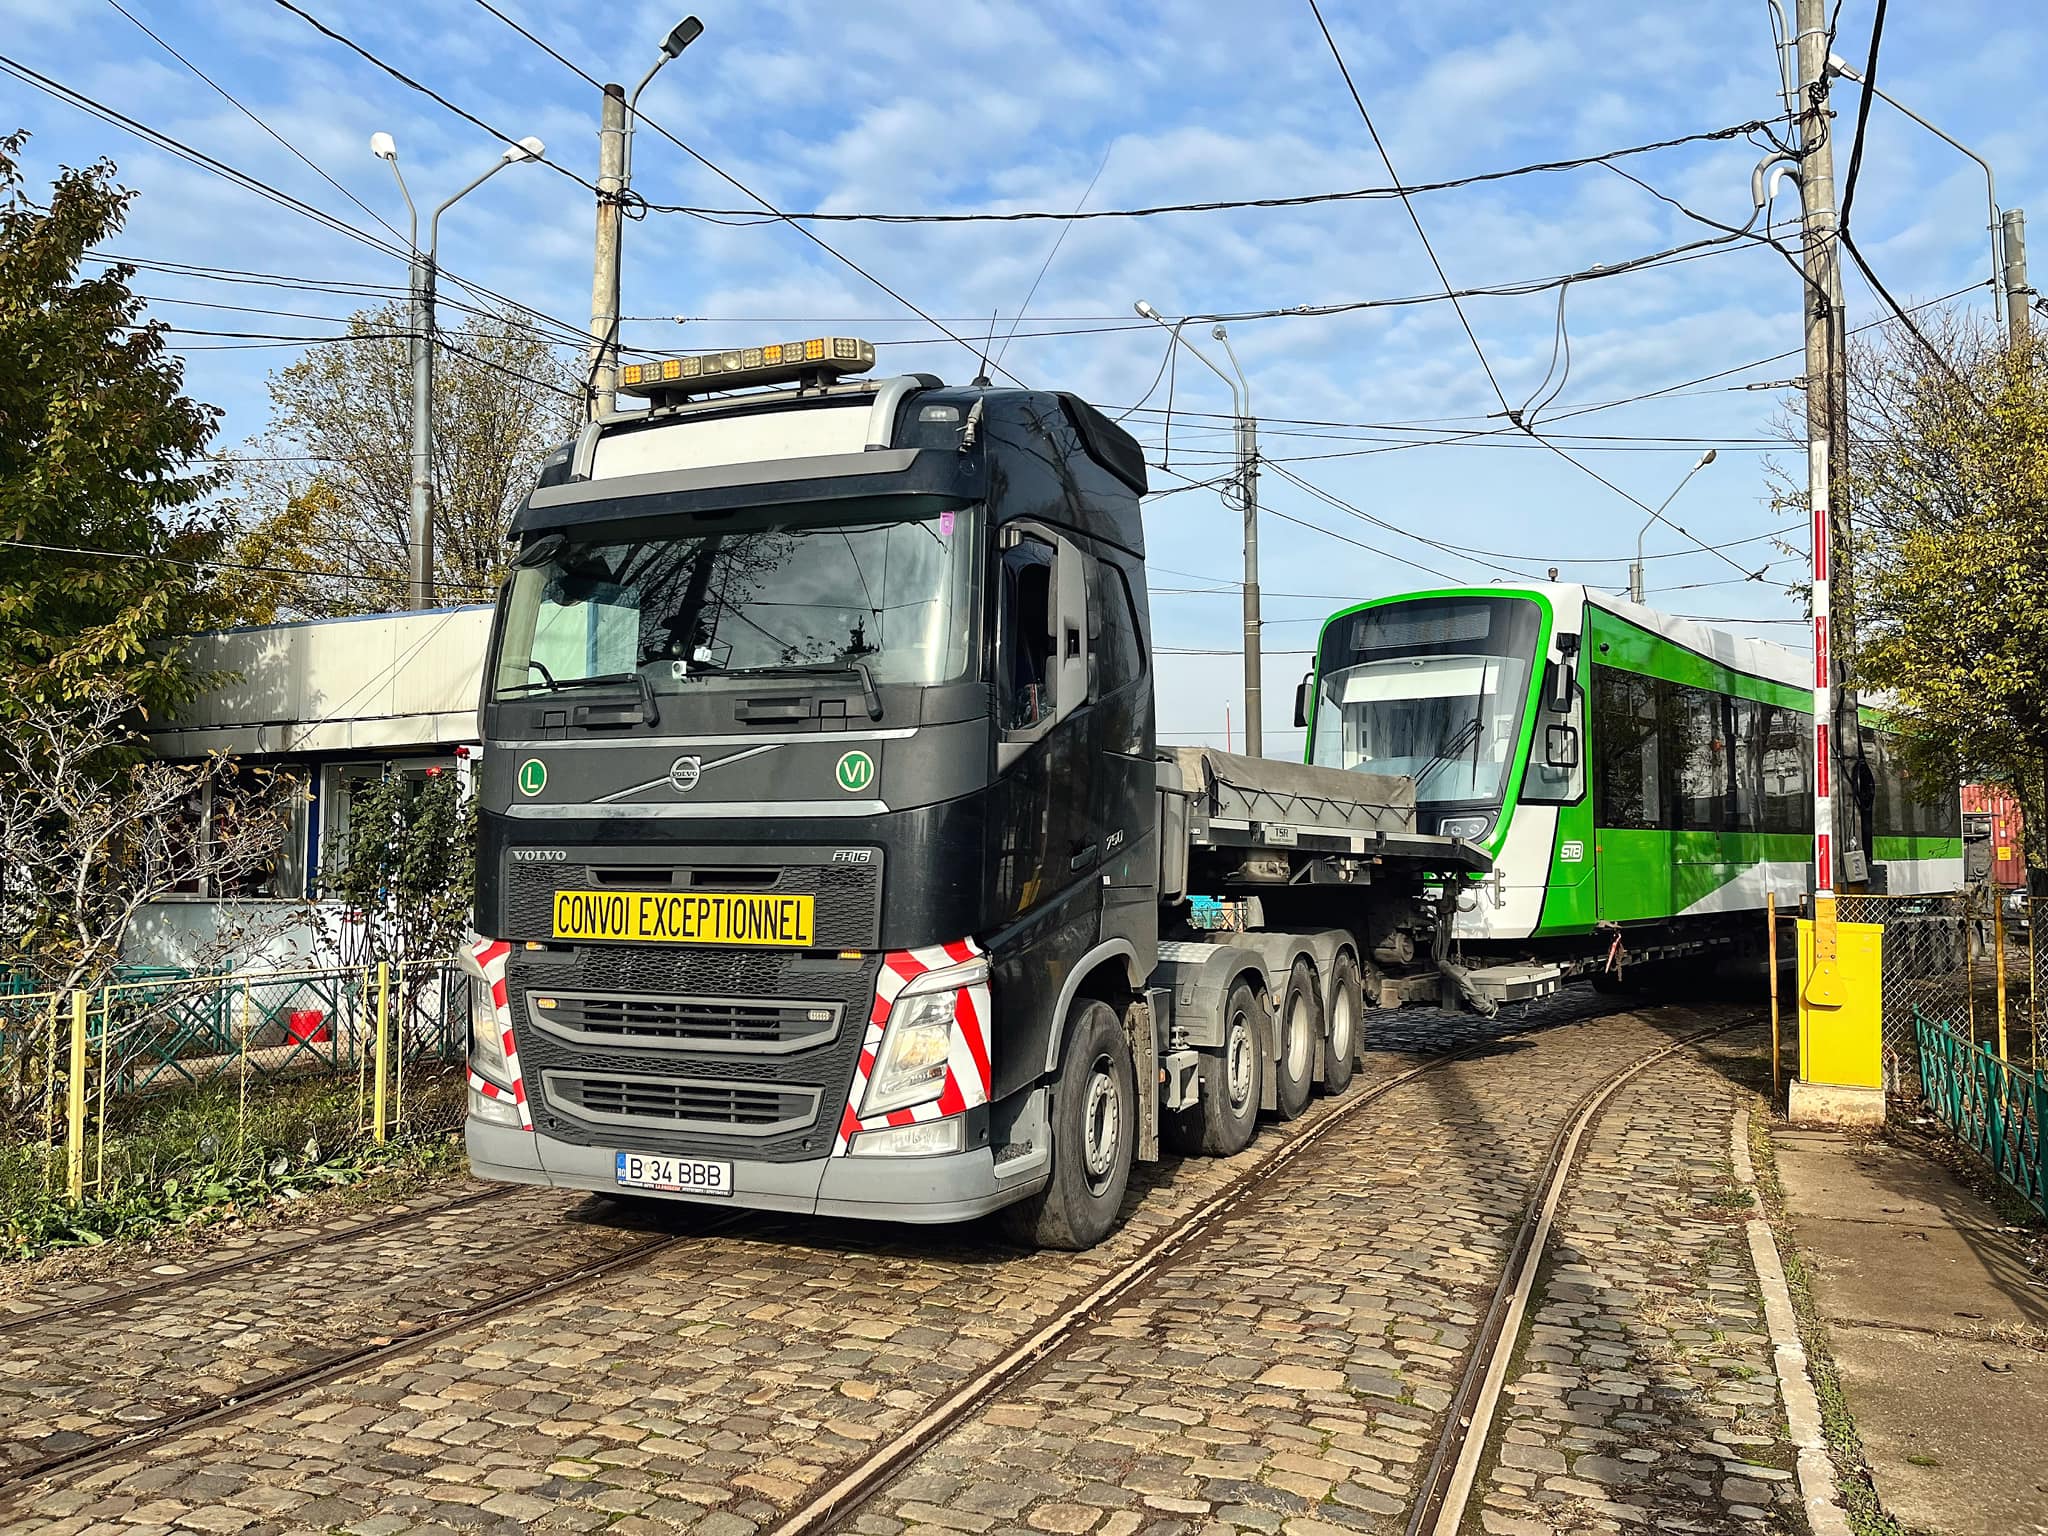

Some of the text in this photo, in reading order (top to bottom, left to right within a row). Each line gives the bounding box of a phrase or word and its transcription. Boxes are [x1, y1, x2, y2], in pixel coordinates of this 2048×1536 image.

[527, 766, 539, 789] L
[843, 760, 866, 783] VI
[1106, 829, 1124, 851] 750
[1275, 828, 1289, 838] TSR
[513, 850, 567, 861] VOLVO
[832, 850, 872, 863] FH16
[1560, 842, 1583, 860] STB
[557, 895, 807, 941] CONVOI EXCEPTIONNEL
[630, 1158, 721, 1186] B 34 BBB
